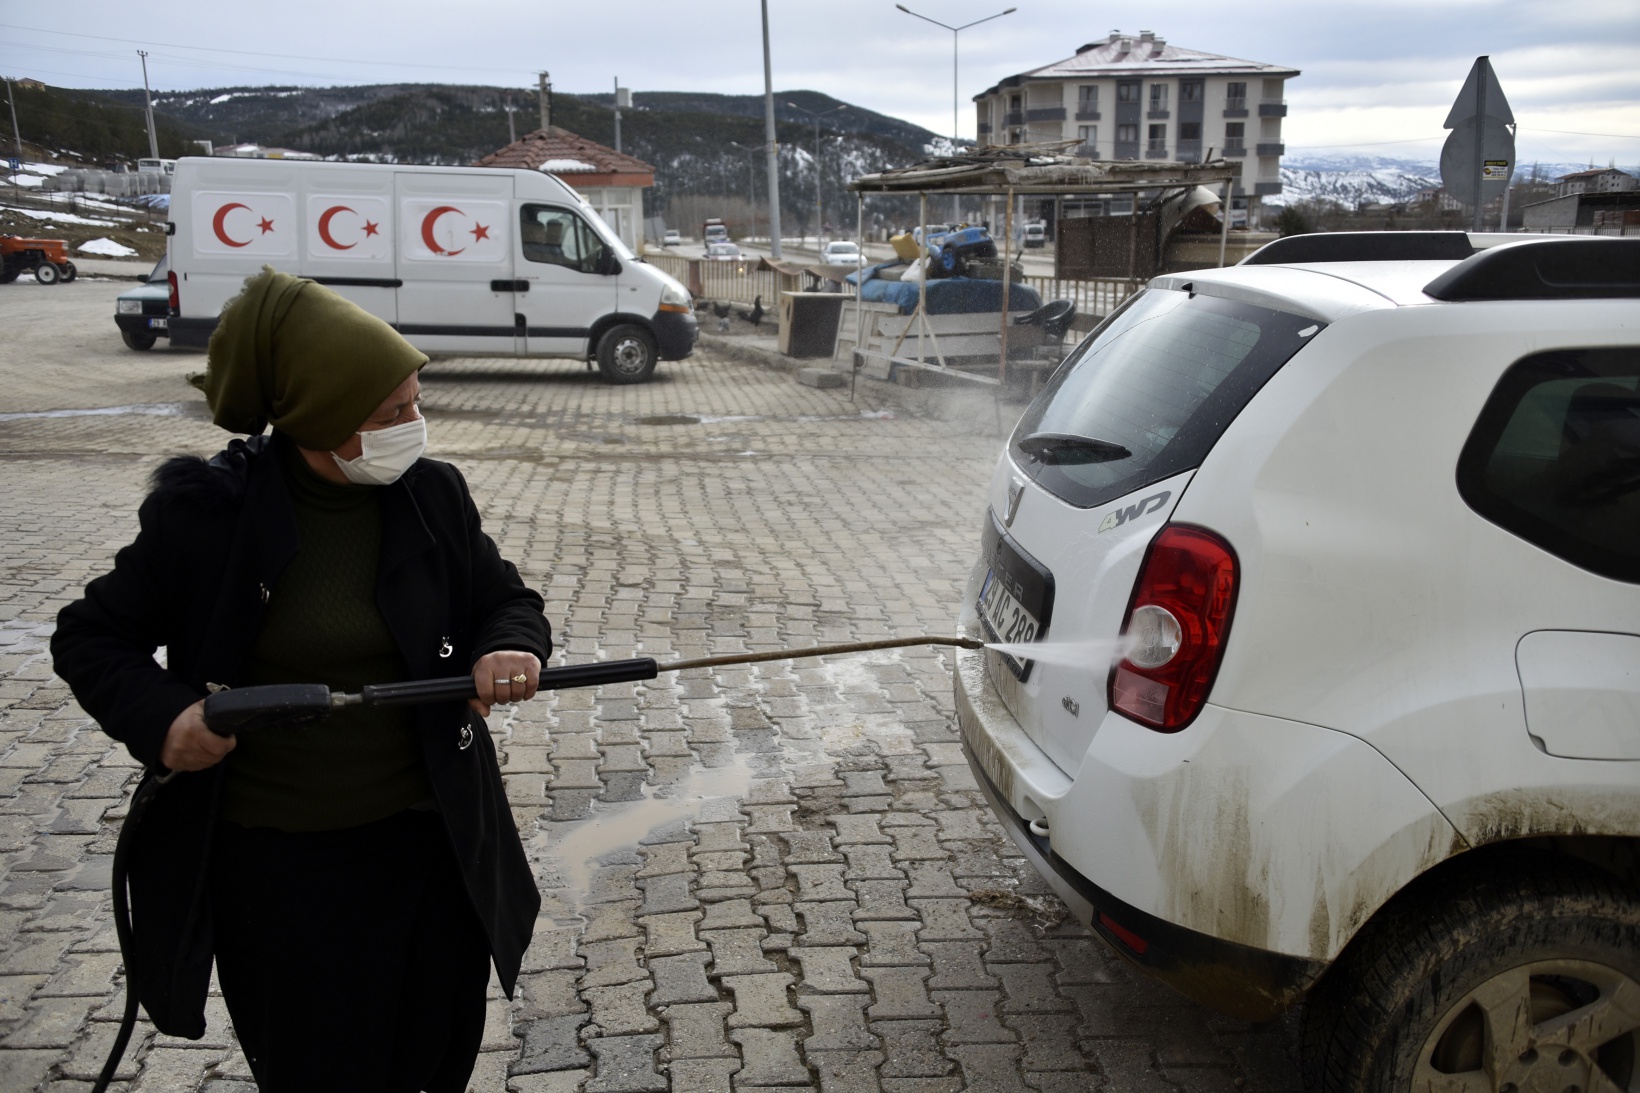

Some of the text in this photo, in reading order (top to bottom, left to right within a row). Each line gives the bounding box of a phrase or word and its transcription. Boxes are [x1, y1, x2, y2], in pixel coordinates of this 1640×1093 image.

[10, 159, 18, 167] H
[1098, 490, 1172, 533] 4WD
[992, 588, 1011, 629] AC
